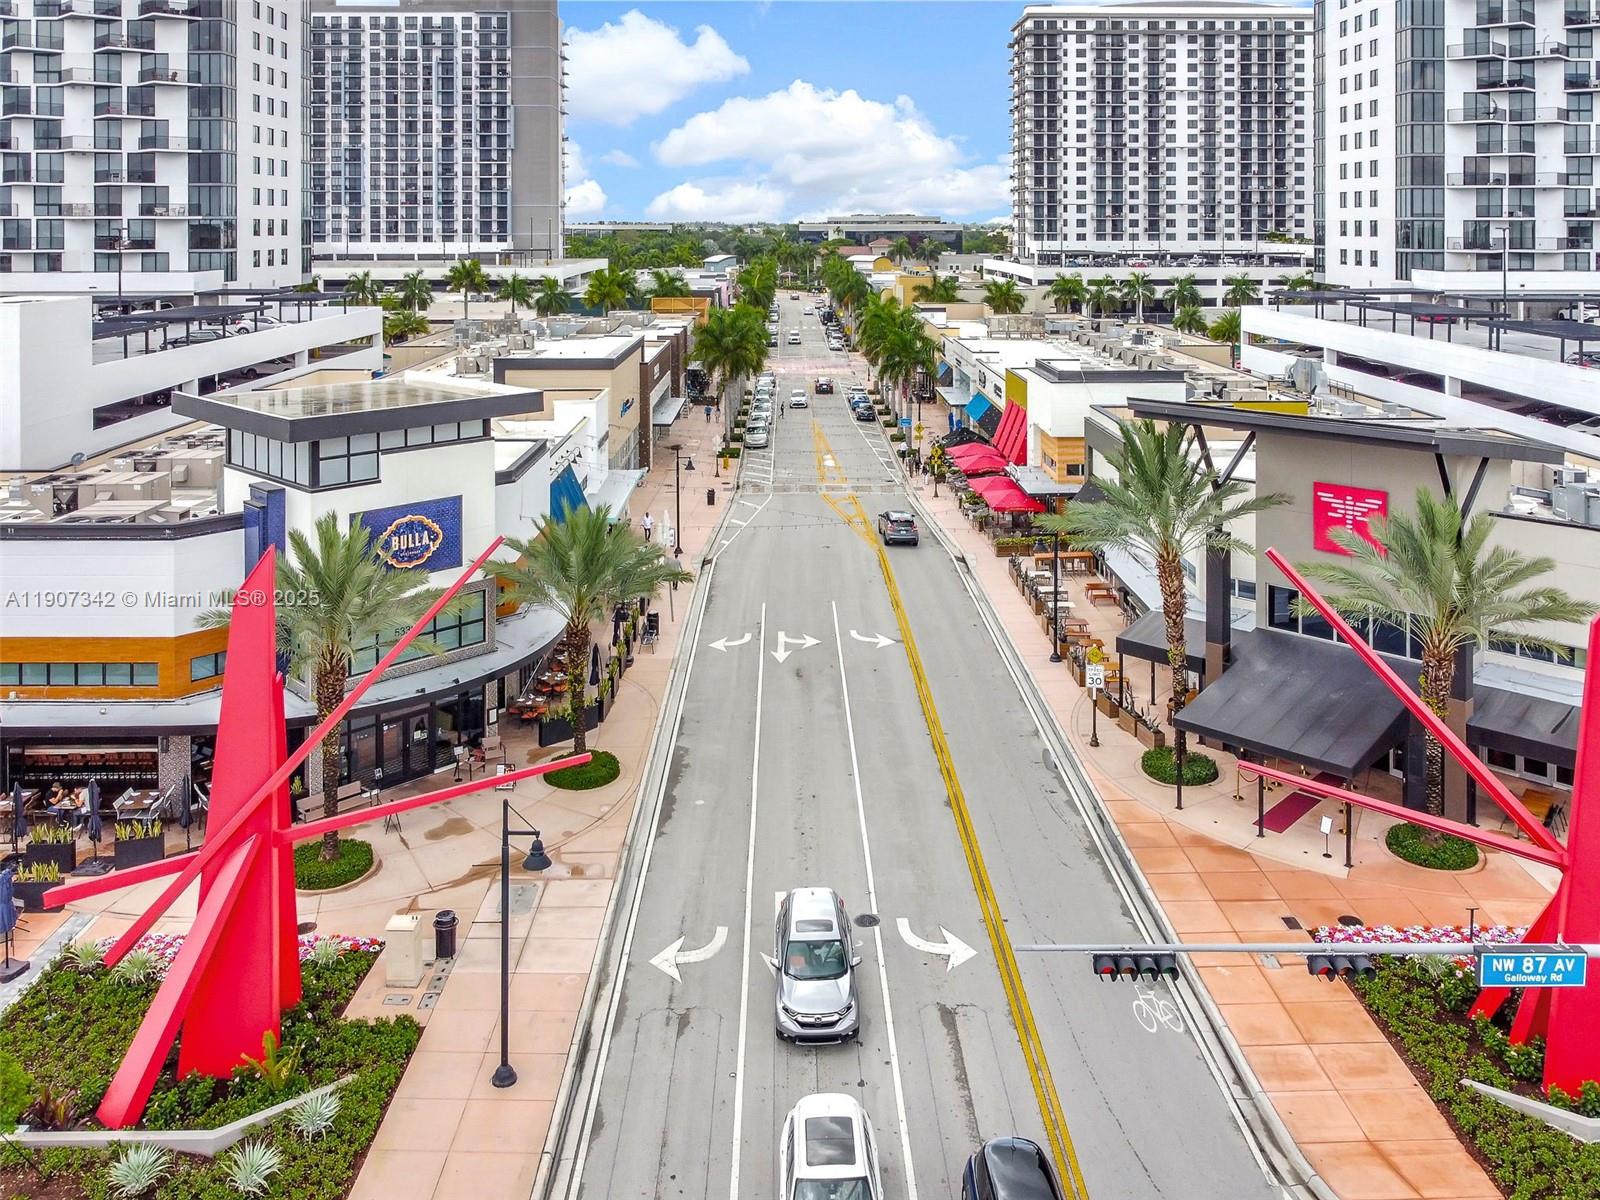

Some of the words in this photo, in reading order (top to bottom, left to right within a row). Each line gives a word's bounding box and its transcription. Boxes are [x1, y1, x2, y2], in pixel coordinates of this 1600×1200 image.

[392, 530, 430, 551] BULLA
[1088, 677, 1102, 686] 30
[1492, 958, 1515, 972] NW
[1522, 957, 1547, 973] 87
[1554, 958, 1575, 972] AV
[1504, 974, 1547, 984] Galloway
[1550, 973, 1563, 982] Rd
